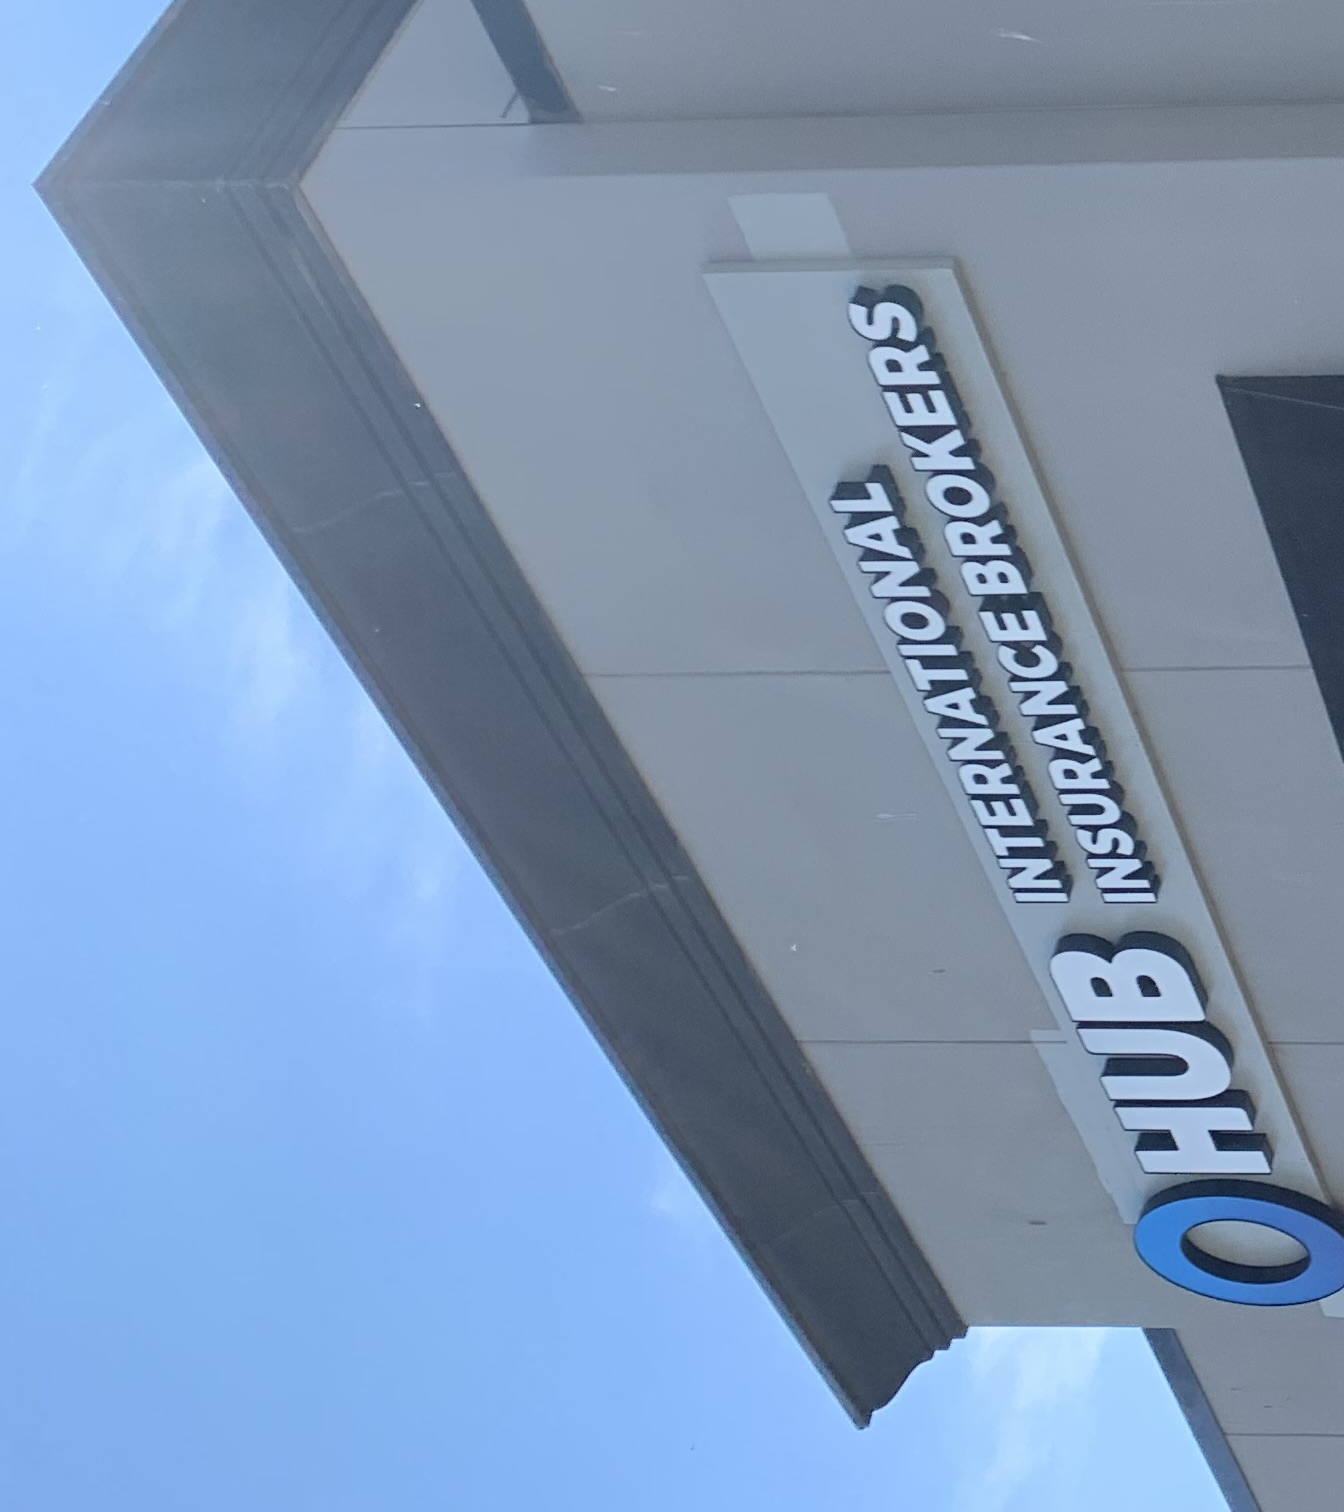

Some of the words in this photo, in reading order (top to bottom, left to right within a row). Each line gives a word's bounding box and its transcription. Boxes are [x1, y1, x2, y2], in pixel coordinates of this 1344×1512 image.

[847, 299, 1028, 596] BROKERS
[829, 481, 1070, 903] INTERNATIONAL
[978, 609, 1158, 903] INSURANCE
[1048, 942, 1272, 1175] HUB
